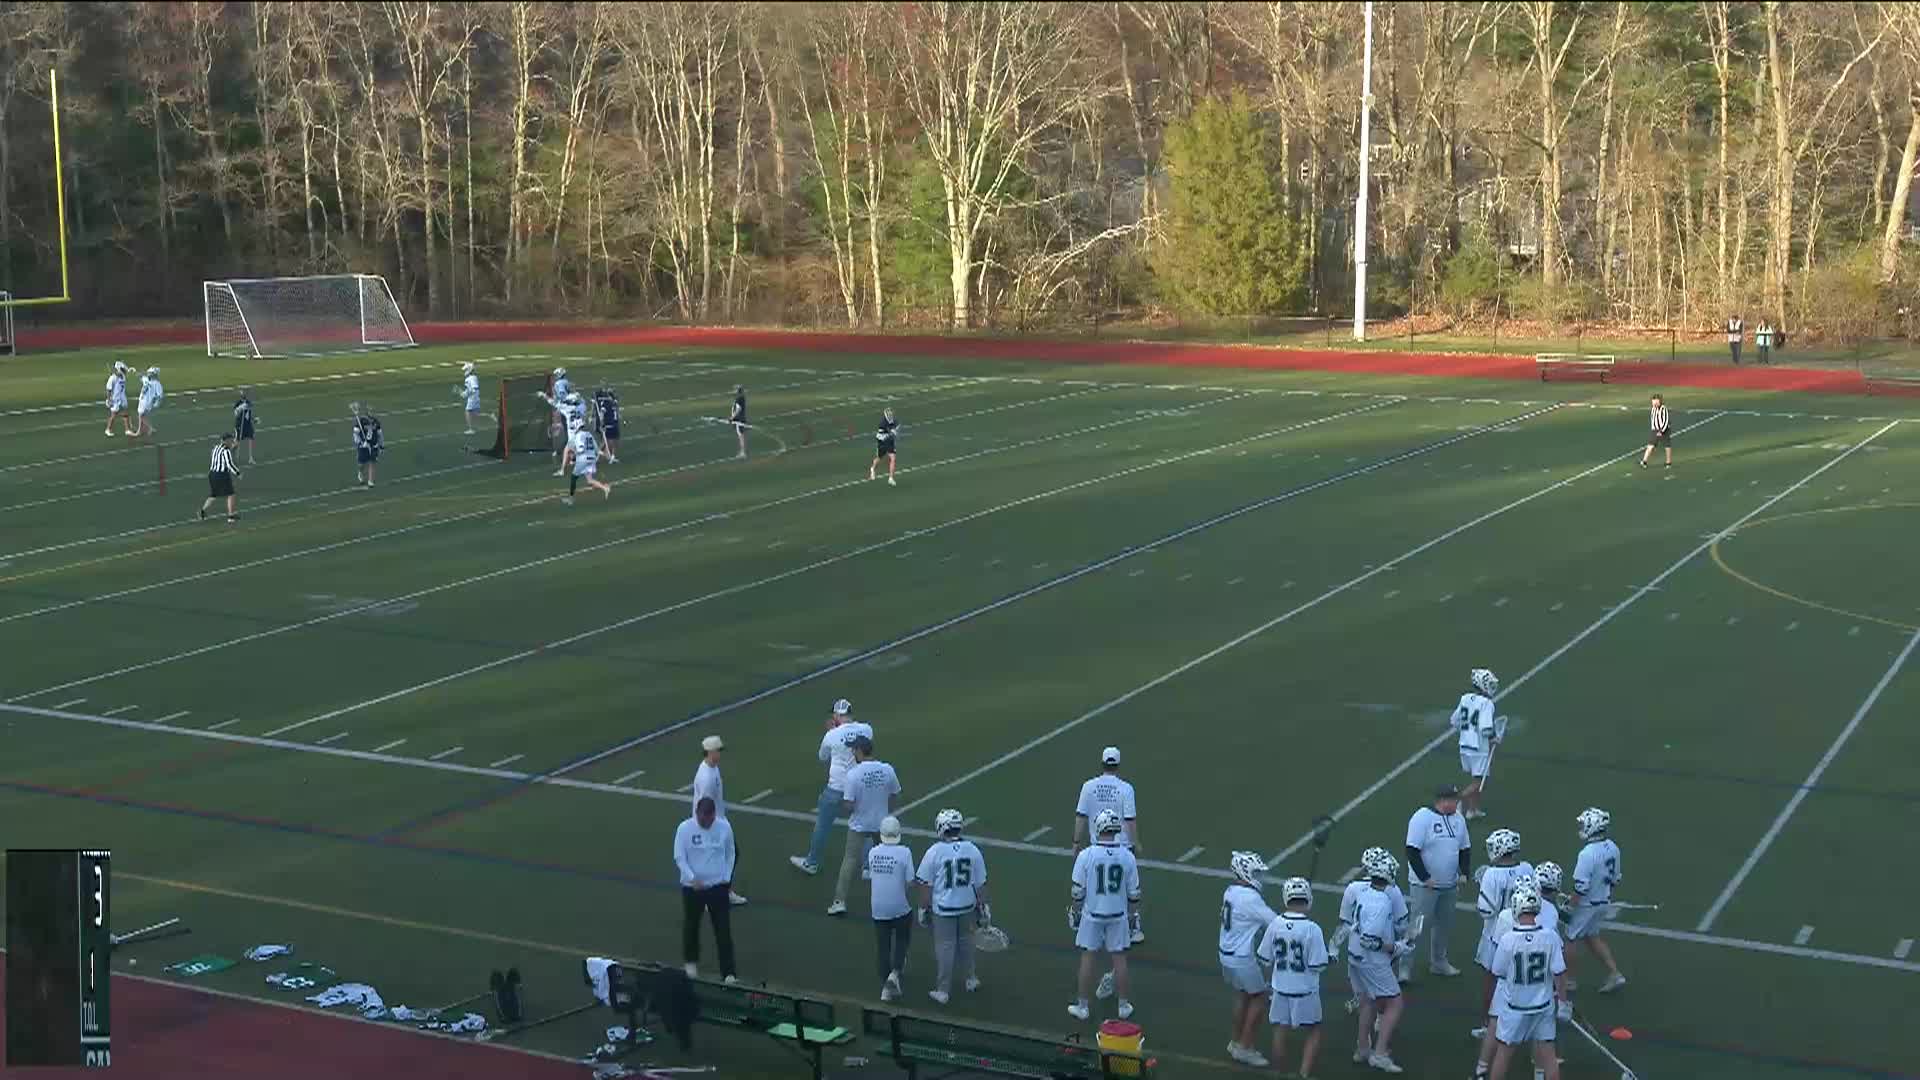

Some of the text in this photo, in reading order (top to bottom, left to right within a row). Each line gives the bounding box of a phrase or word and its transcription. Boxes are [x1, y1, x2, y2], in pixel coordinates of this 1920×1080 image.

[1460, 707, 1480, 730] 24
[1433, 823, 1443, 833] C
[943, 858, 971, 889] 15
[1095, 863, 1124, 895] 19
[1273, 937, 1305, 973] 23
[1513, 951, 1548, 986] 12
